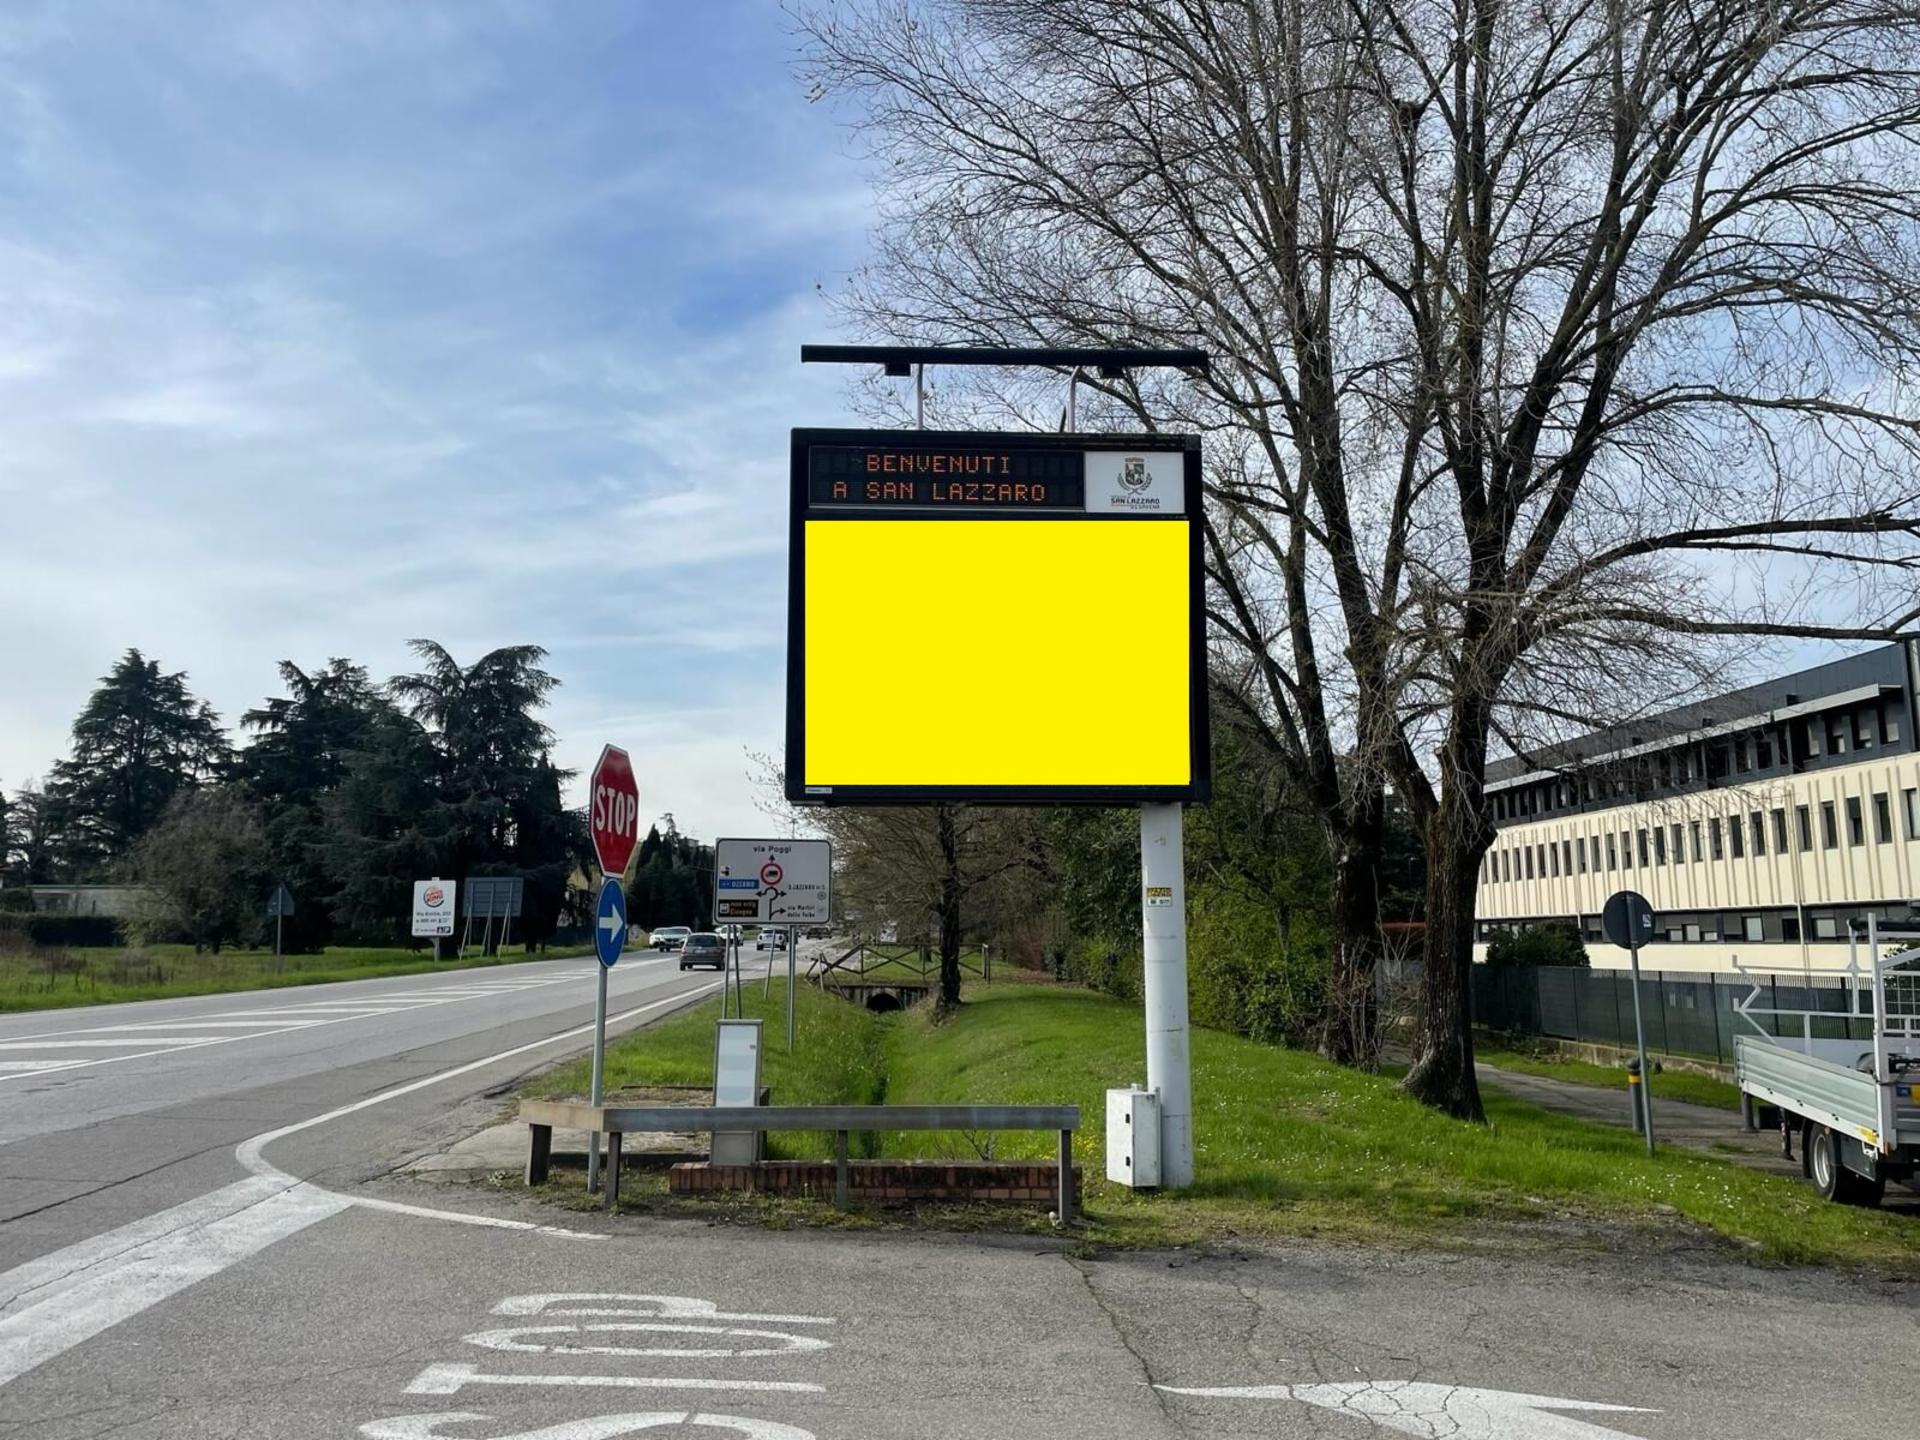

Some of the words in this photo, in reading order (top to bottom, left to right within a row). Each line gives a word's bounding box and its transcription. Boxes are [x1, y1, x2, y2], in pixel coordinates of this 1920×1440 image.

[867, 455, 1009, 473] BENVENUTI
[833, 481, 847, 499] A
[866, 482, 913, 499] SAN
[932, 483, 1045, 501] LAZZARO
[596, 784, 636, 838] STOP
[768, 846, 792, 854] Poggi
